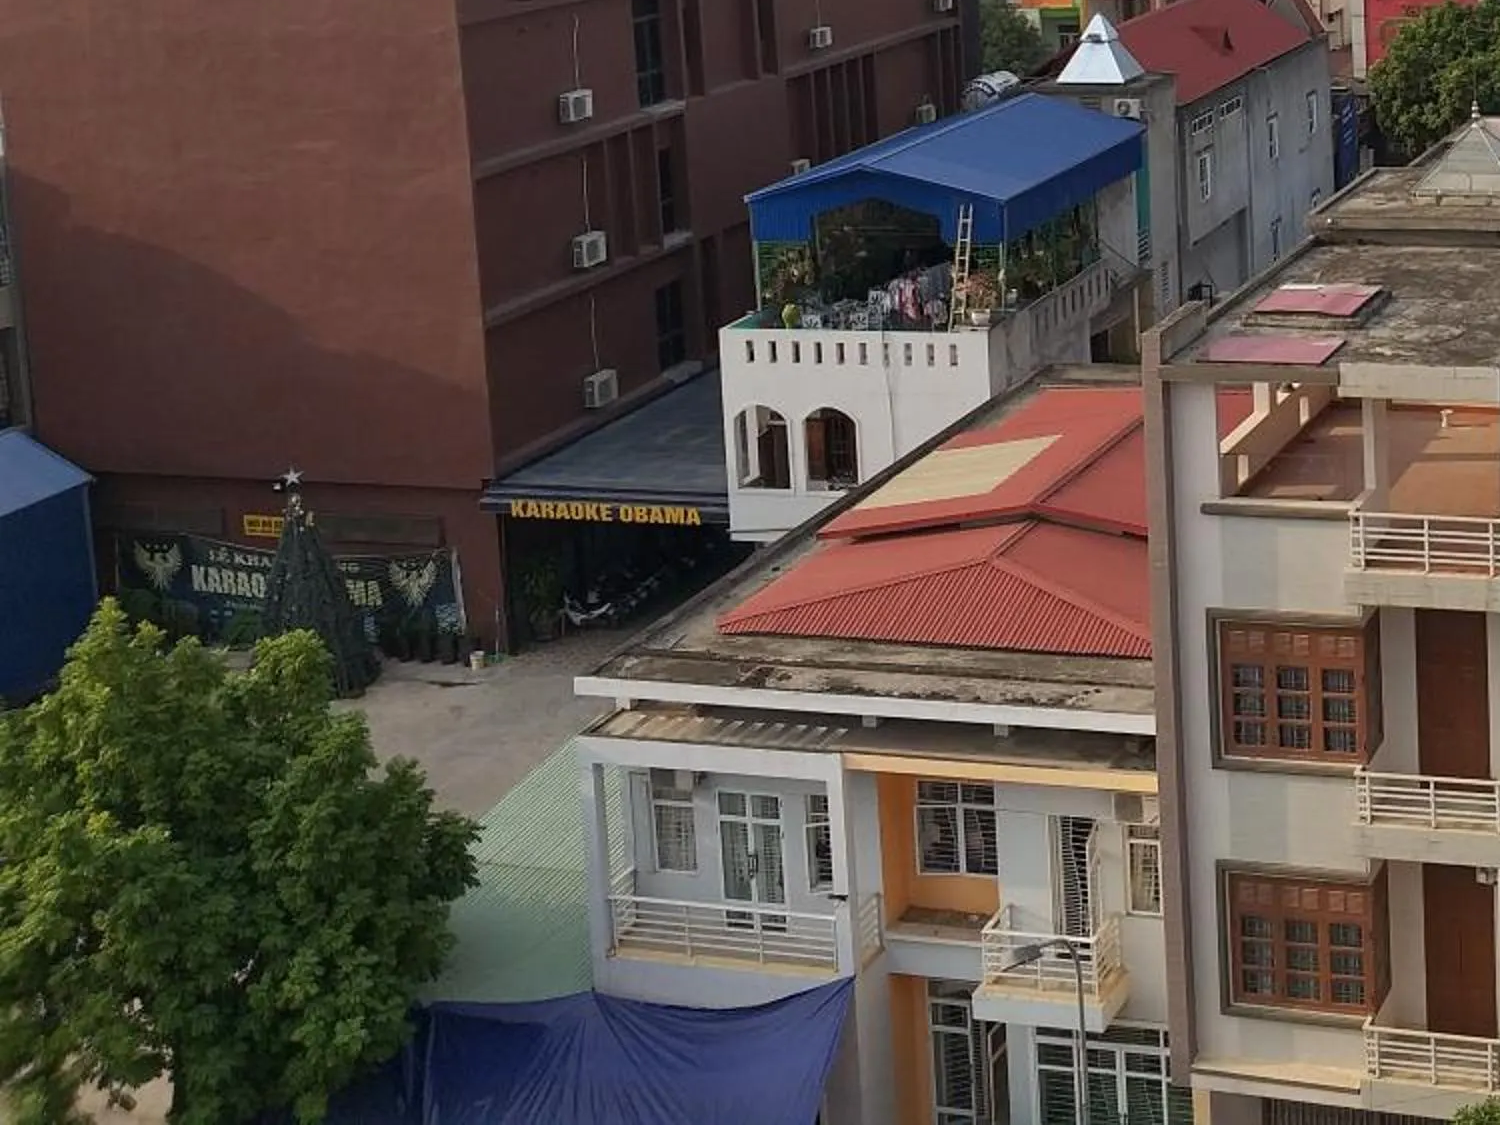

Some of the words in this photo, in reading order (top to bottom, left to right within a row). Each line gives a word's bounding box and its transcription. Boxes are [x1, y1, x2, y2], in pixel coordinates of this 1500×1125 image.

[511, 499, 613, 522] KARAOKE
[619, 505, 700, 525] OBAMA
[191, 565, 268, 599] KARAO
